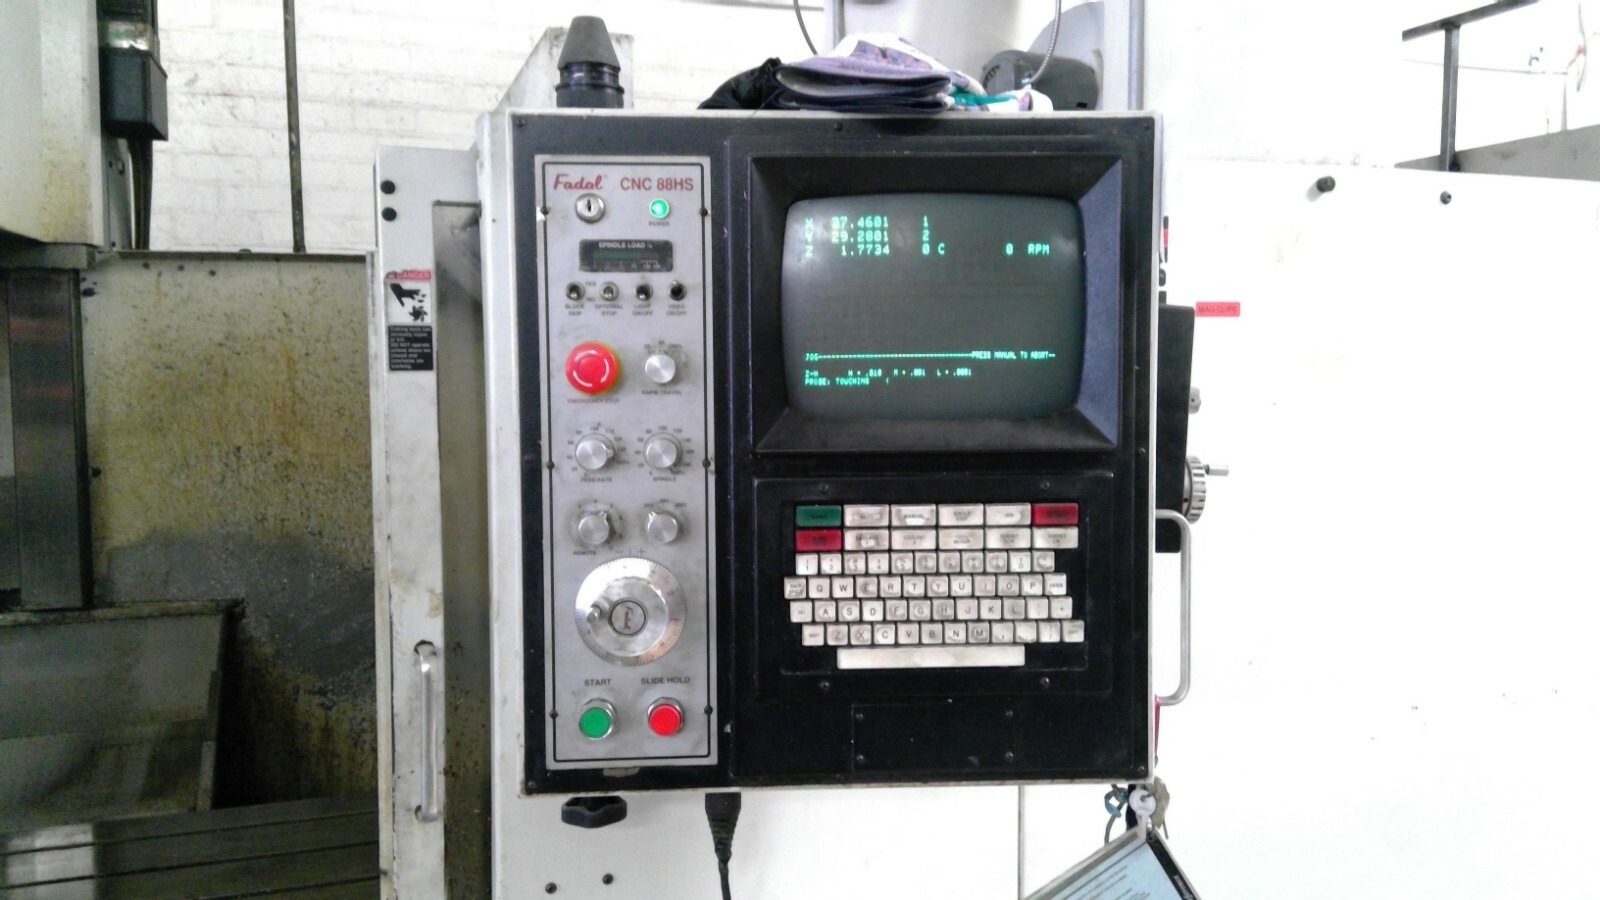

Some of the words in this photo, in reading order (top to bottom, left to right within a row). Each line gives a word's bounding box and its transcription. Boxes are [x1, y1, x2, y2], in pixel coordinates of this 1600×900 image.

[553, 173, 603, 190] Fadal
[620, 177, 652, 191] CNC
[656, 177, 694, 191] 88HS
[805, 216, 814, 228] X
[922, 216, 928, 227] 1
[805, 232, 814, 243] Y
[922, 230, 930, 241] 2
[805, 245, 814, 257] Z
[841, 244, 890, 256] 1.7734
[922, 244, 930, 256] 0
[938, 243, 946, 256] C
[1028, 242, 1050, 256] RPM
[836, 376, 870, 386] TOUCHING
[839, 584, 848, 592] W
[888, 583, 894, 591] R
[912, 583, 918, 591] T
[958, 582, 965, 590] U
[1006, 582, 1013, 590] O
[847, 607, 853, 616] S
[870, 607, 876, 616] D
[918, 606, 924, 615] G
[965, 606, 971, 614] J
[988, 605, 994, 614] K
[834, 631, 840, 639] Z
[857, 631, 865, 639] X
[882, 630, 888, 638] C
[953, 630, 959, 638] N
